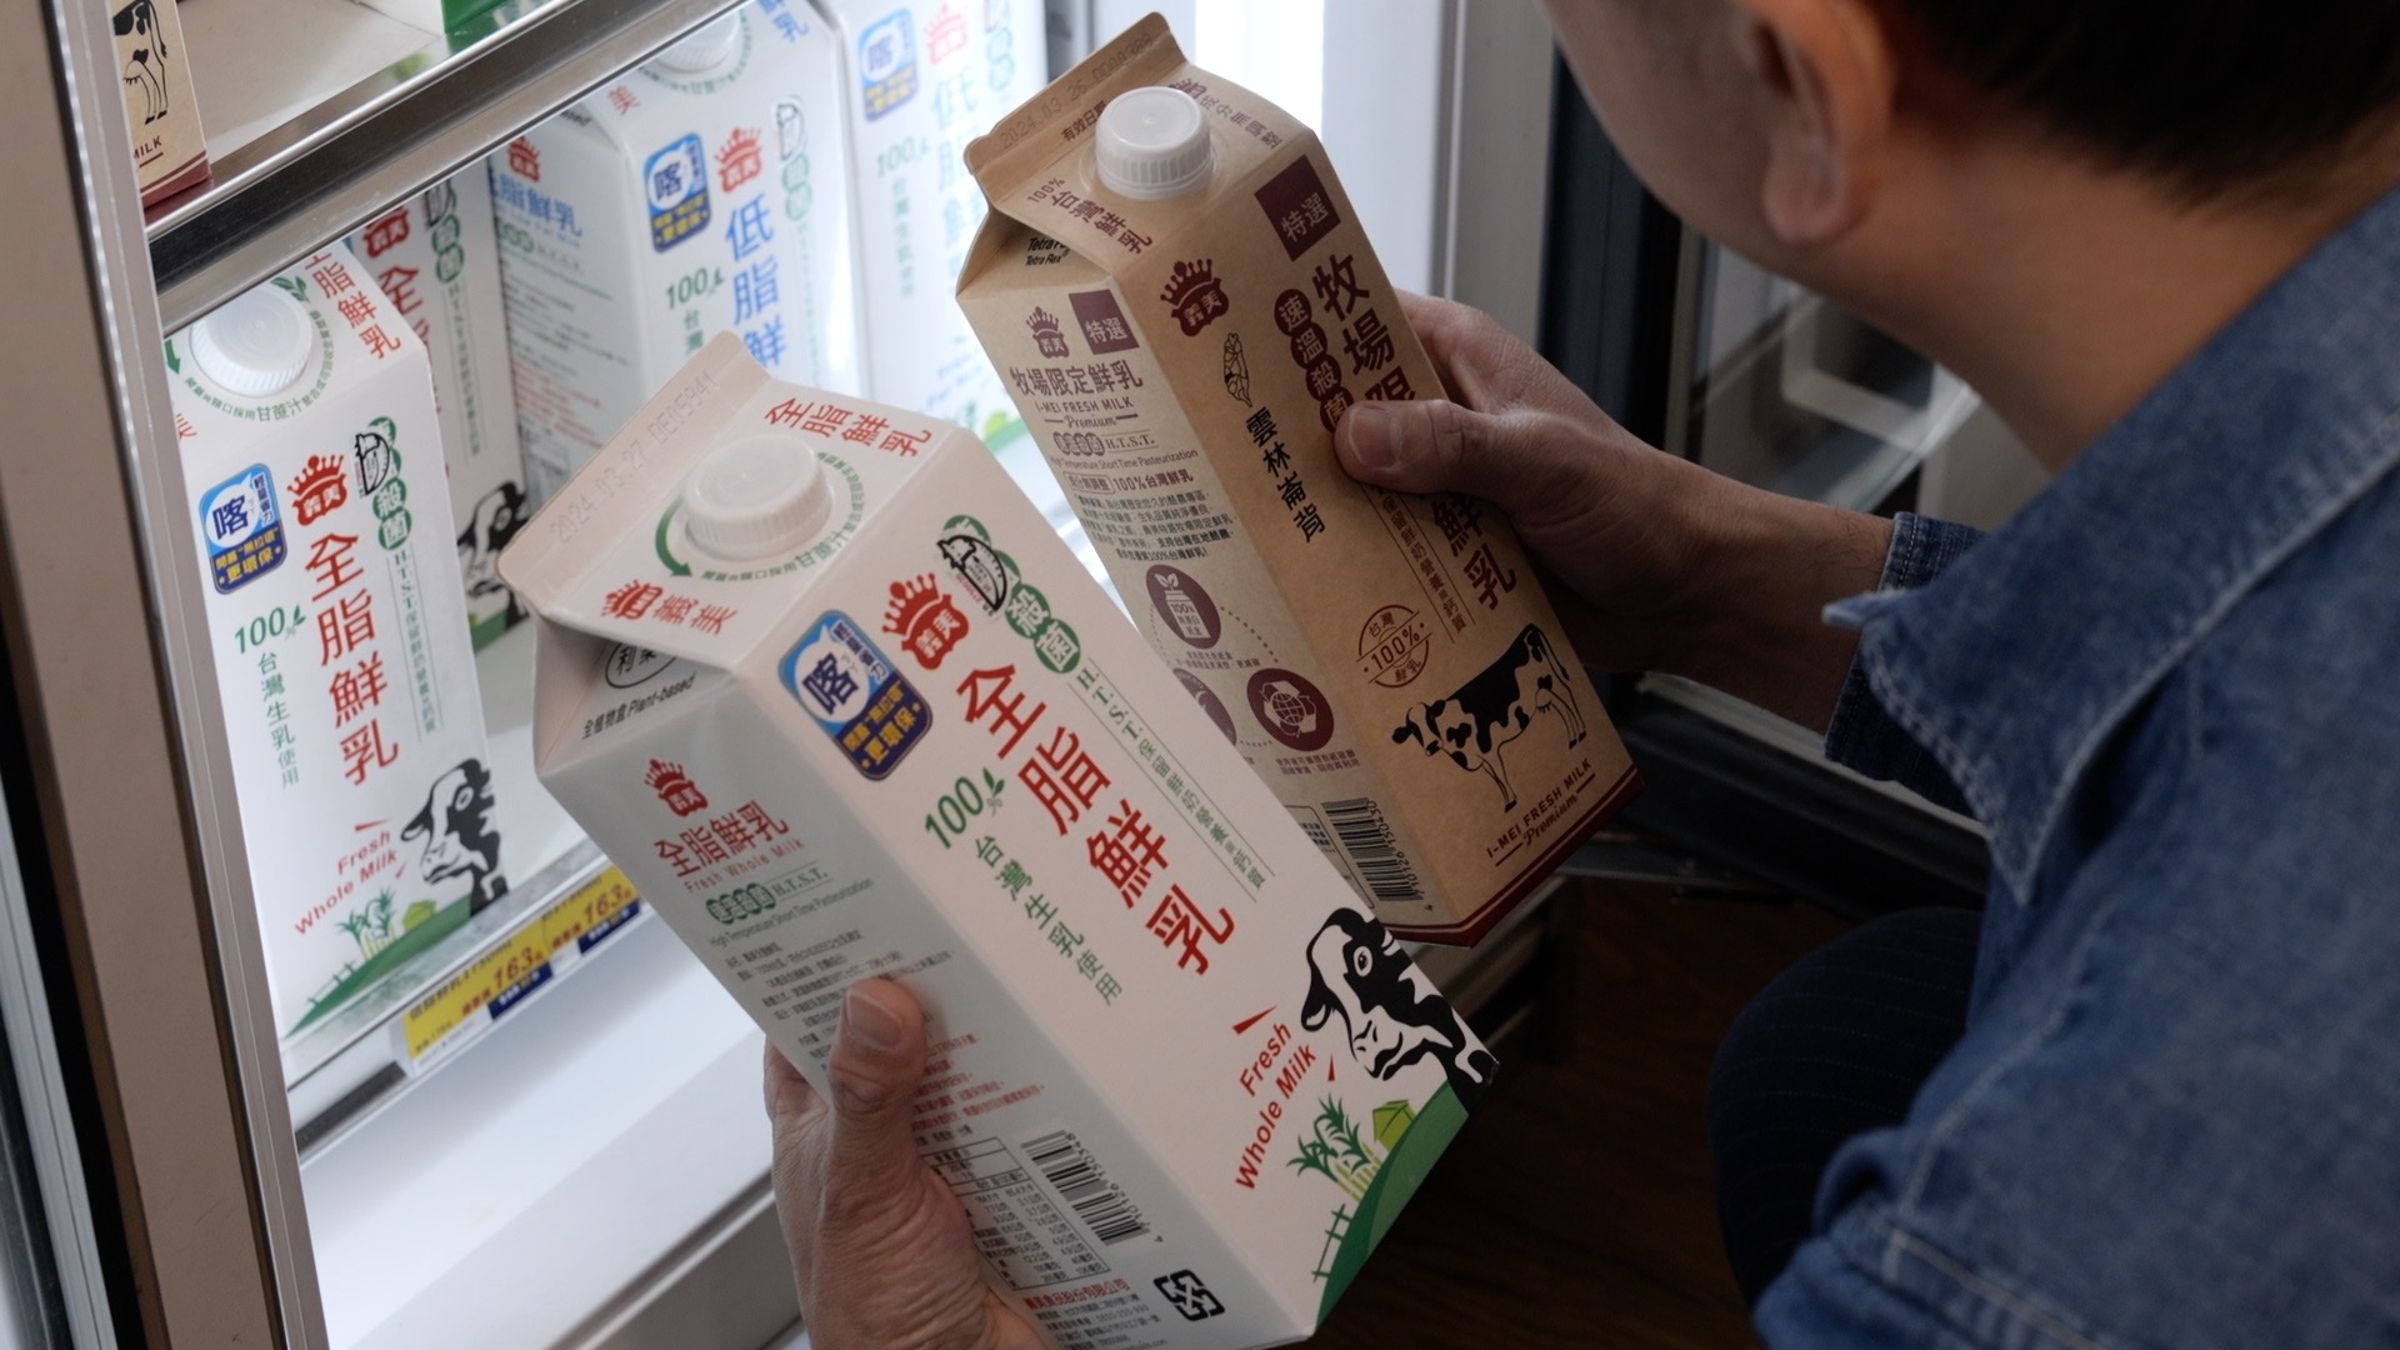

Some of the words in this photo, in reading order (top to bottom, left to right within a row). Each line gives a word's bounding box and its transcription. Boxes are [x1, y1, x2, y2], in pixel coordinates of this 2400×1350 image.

[1051, 191, 1153, 254] 台灣鮮乳
[1279, 192, 1330, 243] 特選
[1086, 319, 1128, 345] 特選
[1010, 360, 1143, 397] 牧場限定鮮乳
[1064, 399, 1100, 413] FRESH
[1102, 396, 1134, 411] MILK
[765, 397, 934, 459] 全脂鮮乳
[1246, 408, 1327, 543] 雲林崙背
[210, 494, 249, 542] 喀
[305, 532, 399, 786] 全脂鮮乳
[1371, 625, 1420, 670] 100%
[802, 652, 859, 715] 喀
[257, 651, 300, 789] 台灣生乳使用
[654, 800, 790, 878] 全脂鮮乳
[957, 662, 1235, 975] 全脂鮮乳
[1487, 824, 1522, 858] I-MEI
[1523, 787, 1562, 827] FRESH
[1563, 758, 1591, 790] MILK
[1524, 794, 1578, 846] Premium
[337, 829, 392, 876] Fresh
[684, 872, 722, 894] Fresh
[728, 855, 768, 885] Whole
[773, 839, 805, 861] Milk
[294, 880, 356, 937] Whole
[359, 850, 400, 890] Milk
[974, 833, 1123, 1006] 台灣生乳使用
[1239, 1022, 1292, 1097] Fresh
[1235, 1101, 1283, 1192] Whole
[1275, 1043, 1317, 1100] Milk
